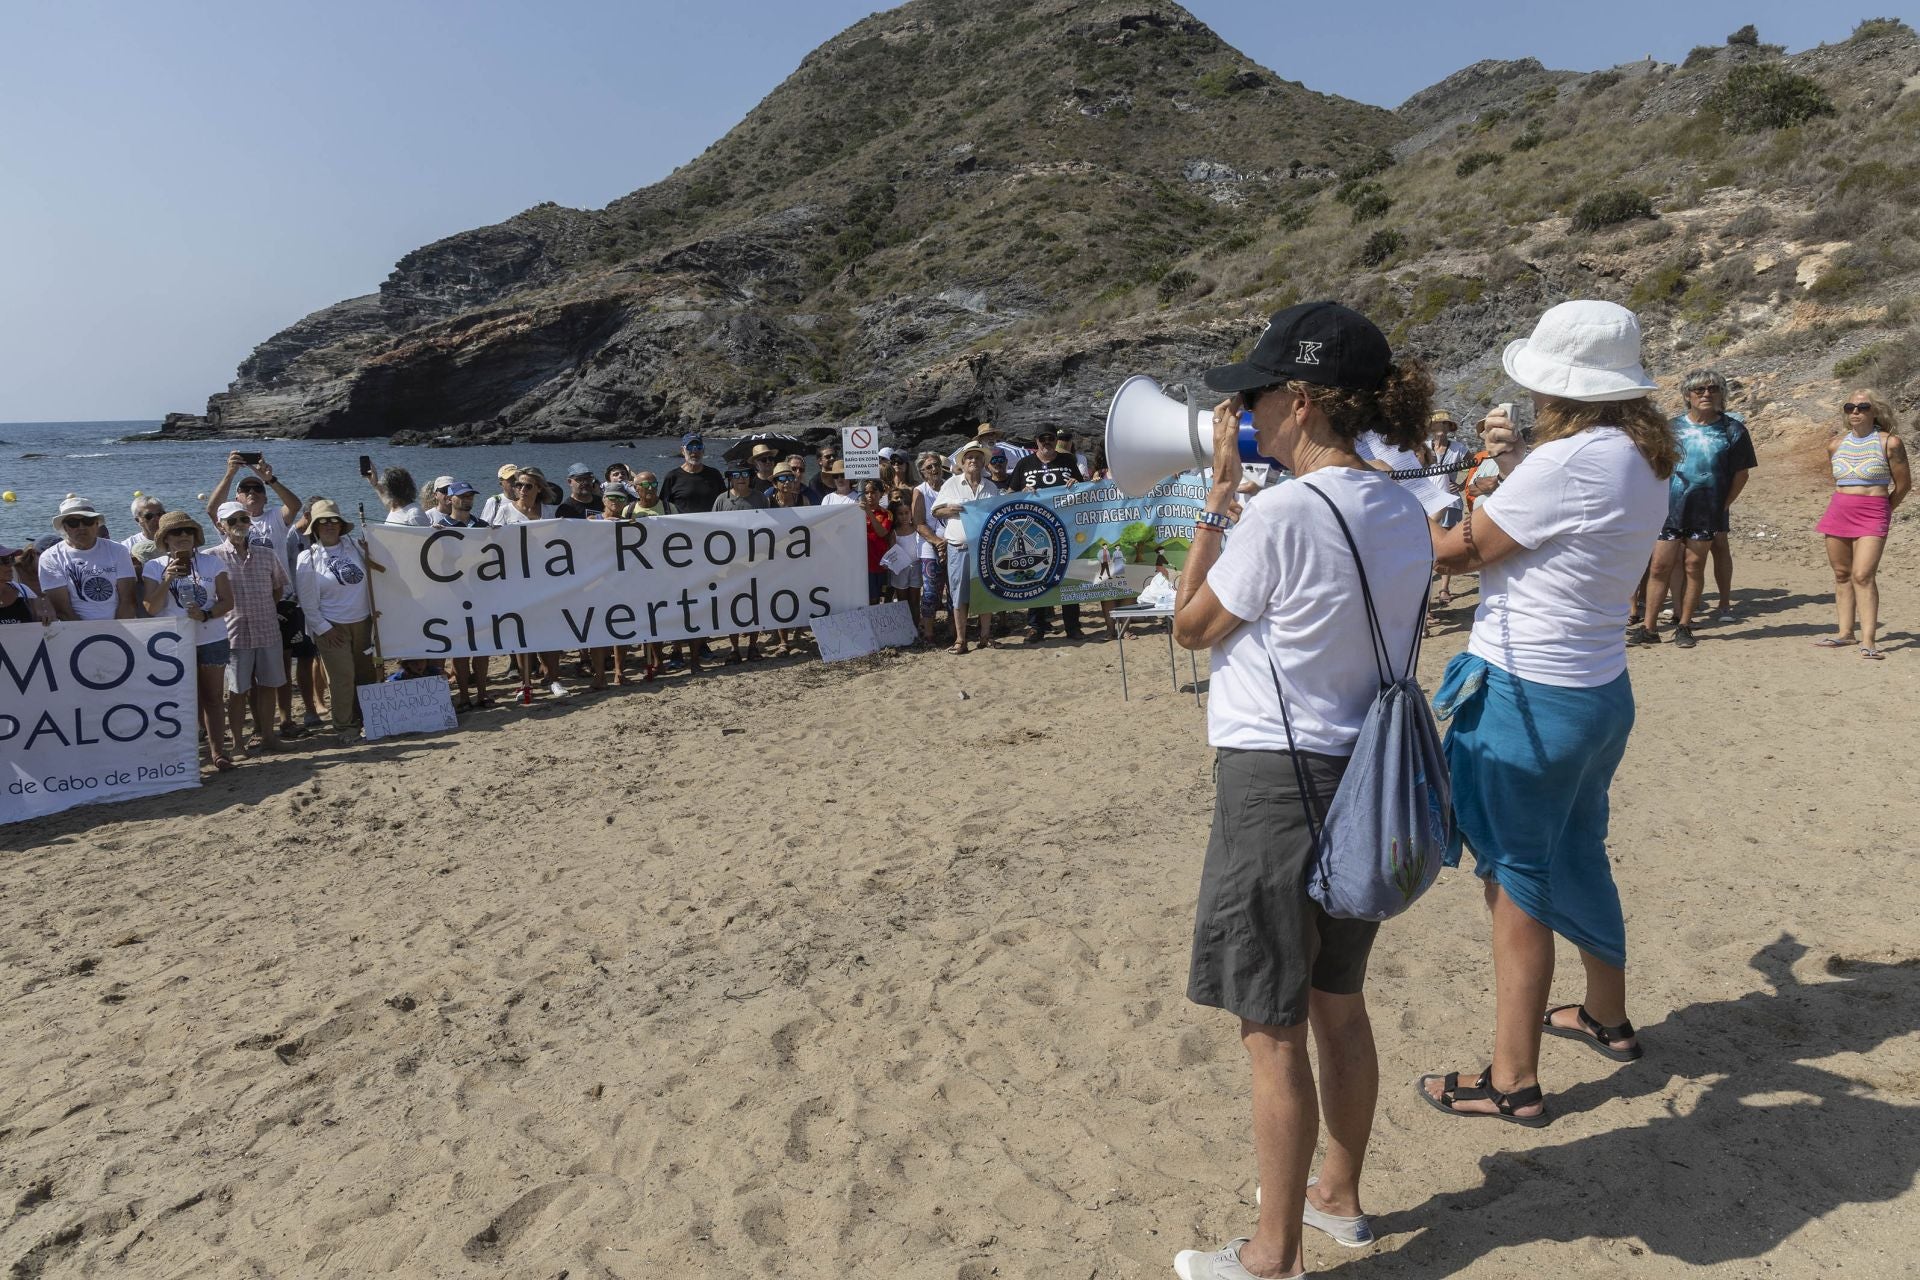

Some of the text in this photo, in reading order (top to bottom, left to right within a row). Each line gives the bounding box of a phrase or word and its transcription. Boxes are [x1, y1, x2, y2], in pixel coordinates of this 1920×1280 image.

[1295, 340, 1323, 365] K
[1025, 471, 1072, 487] SOS
[1053, 484, 1124, 509] FEDERACIÓN
[1014, 503, 1056, 523] CARTAGENA
[1054, 520, 1061, 528] Y
[1074, 507, 1141, 525] CARTAGENA
[1143, 505, 1153, 521] Y
[419, 520, 812, 583] Cala Reona
[1057, 527, 1068, 564] COMARCA
[1003, 585, 1047, 599] ISAAC PERAL
[425, 600, 528, 653] sin
[561, 577, 832, 643] vertidos
[0, 631, 185, 695] MOS
[0, 701, 182, 750] PALOS
[8, 762, 186, 795] de Cabo de Palos
